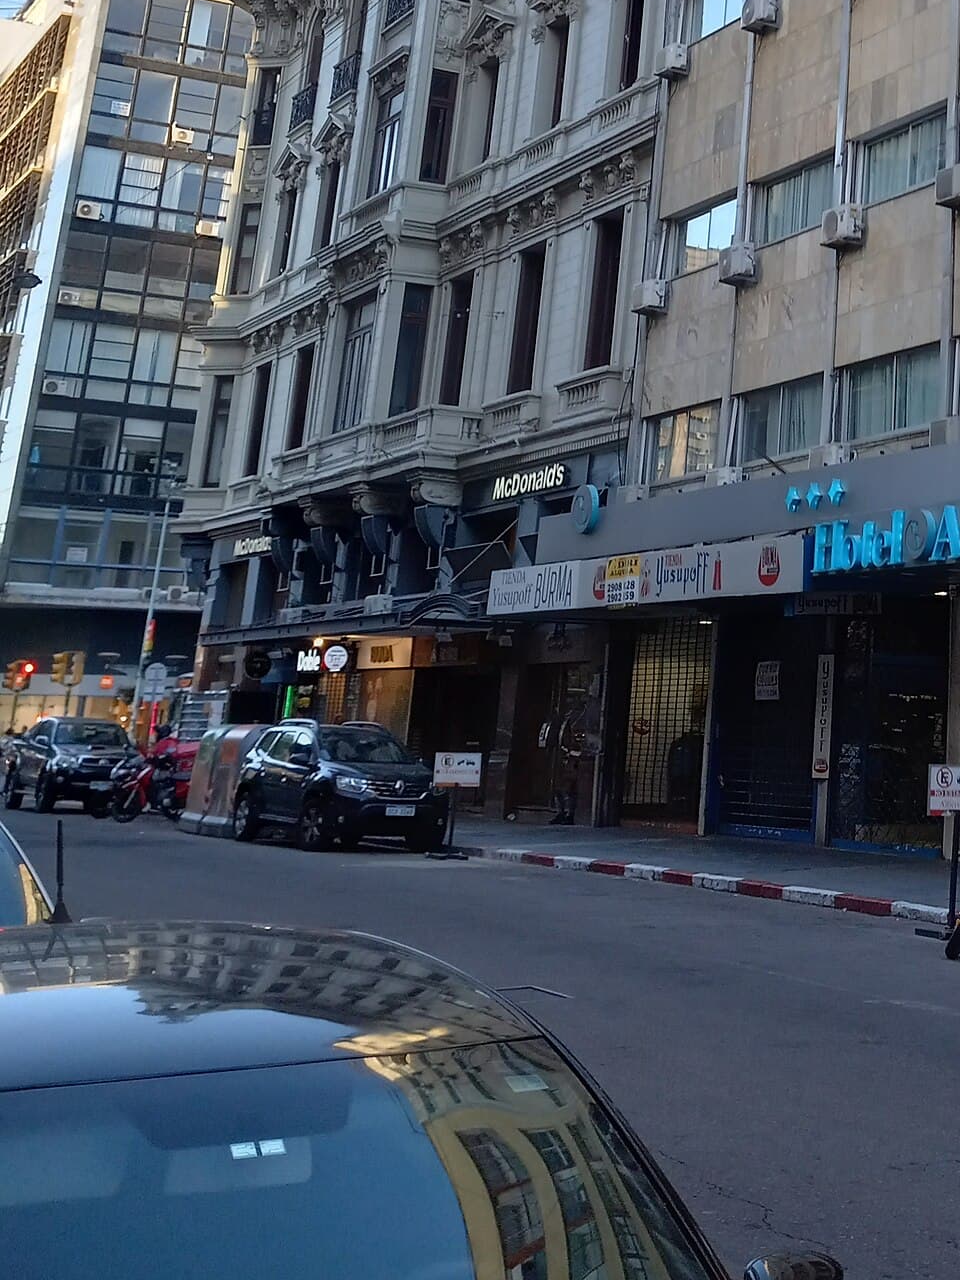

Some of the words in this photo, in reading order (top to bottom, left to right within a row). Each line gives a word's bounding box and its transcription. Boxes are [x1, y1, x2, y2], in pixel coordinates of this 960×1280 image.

[492, 463, 565, 500] McDonald's
[811, 509, 905, 573] Hotel
[502, 570, 526, 585] TIENDA
[534, 564, 573, 609] BURMA
